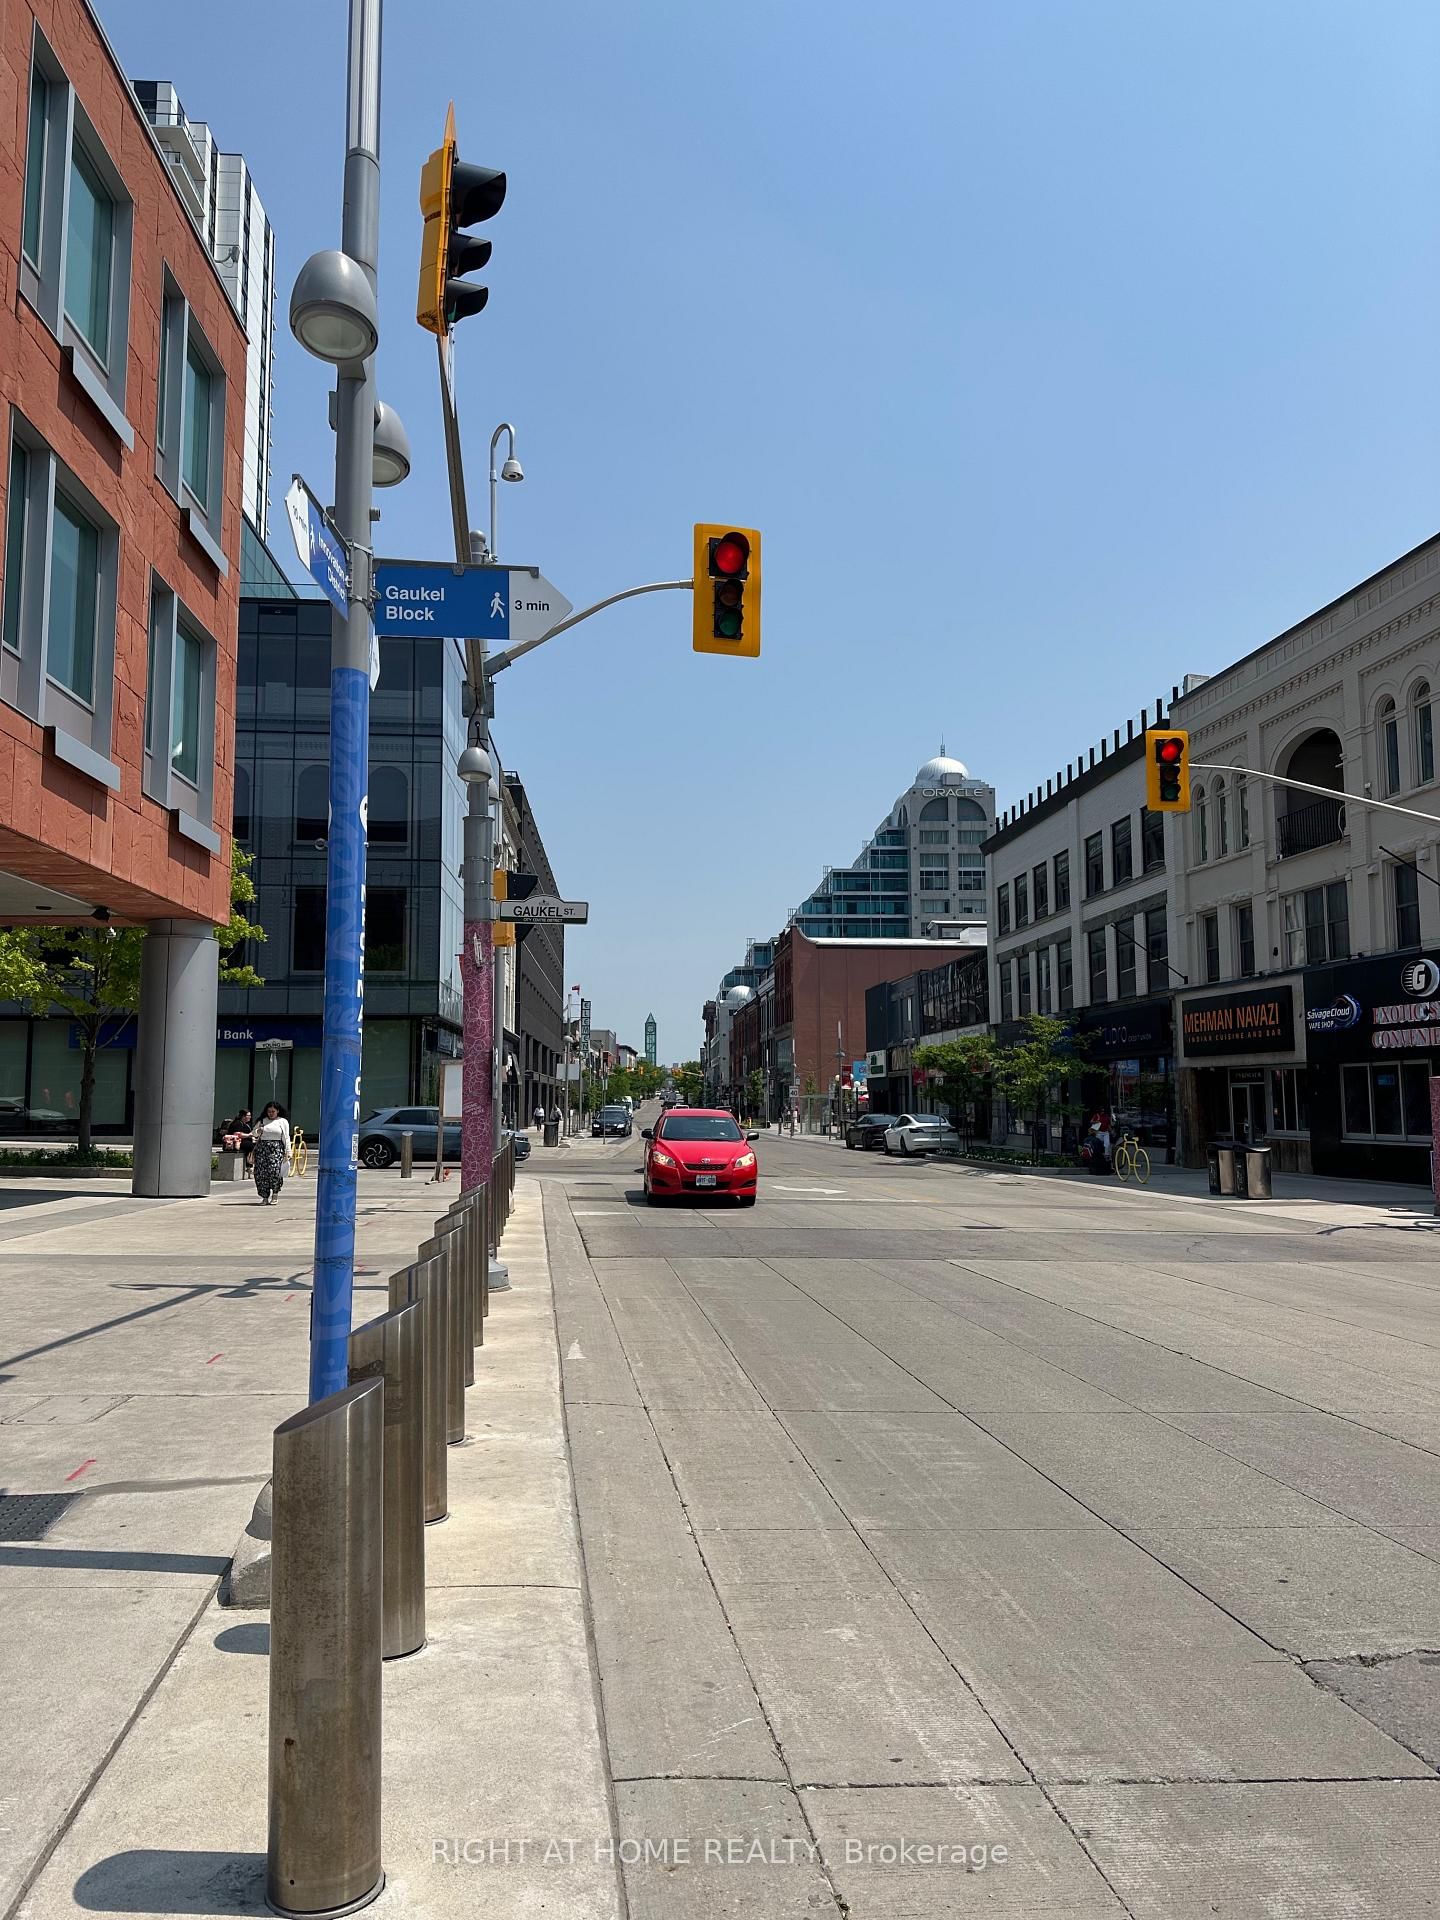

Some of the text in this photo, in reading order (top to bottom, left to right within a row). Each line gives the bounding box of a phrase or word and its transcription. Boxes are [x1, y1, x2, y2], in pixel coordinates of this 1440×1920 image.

[385, 585, 445, 602] Gaukel
[514, 599, 550, 611] 3 min
[385, 606, 435, 622] Block
[922, 788, 984, 798] ORACLE
[513, 905, 563, 917] GAUKEL
[1184, 1002, 1280, 1033] MEHMAN NAVAZI
[582, 1001, 590, 1058] ELEMENT
[1321, 1019, 1334, 1029] SHOP
[223, 1028, 254, 1040] Bank
